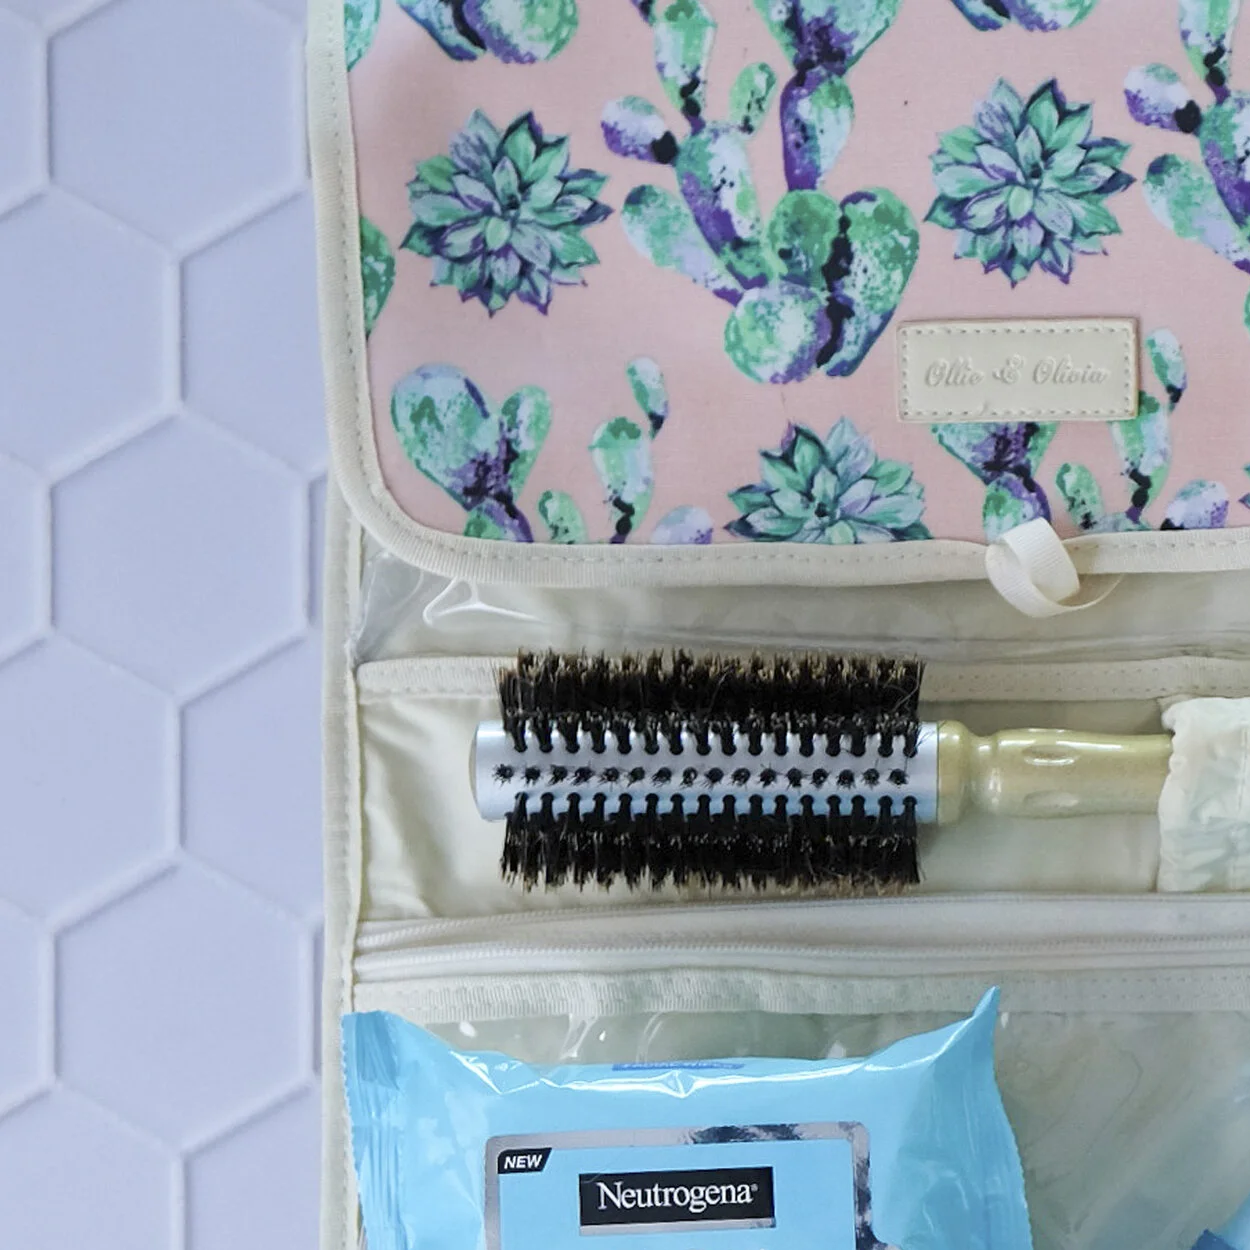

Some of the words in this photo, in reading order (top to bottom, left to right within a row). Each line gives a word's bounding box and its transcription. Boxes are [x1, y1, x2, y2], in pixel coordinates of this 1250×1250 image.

[924, 356, 984, 388] Ollie
[992, 352, 1025, 385] &
[1032, 354, 1111, 386] Olivia
[503, 1154, 543, 1170] NEW
